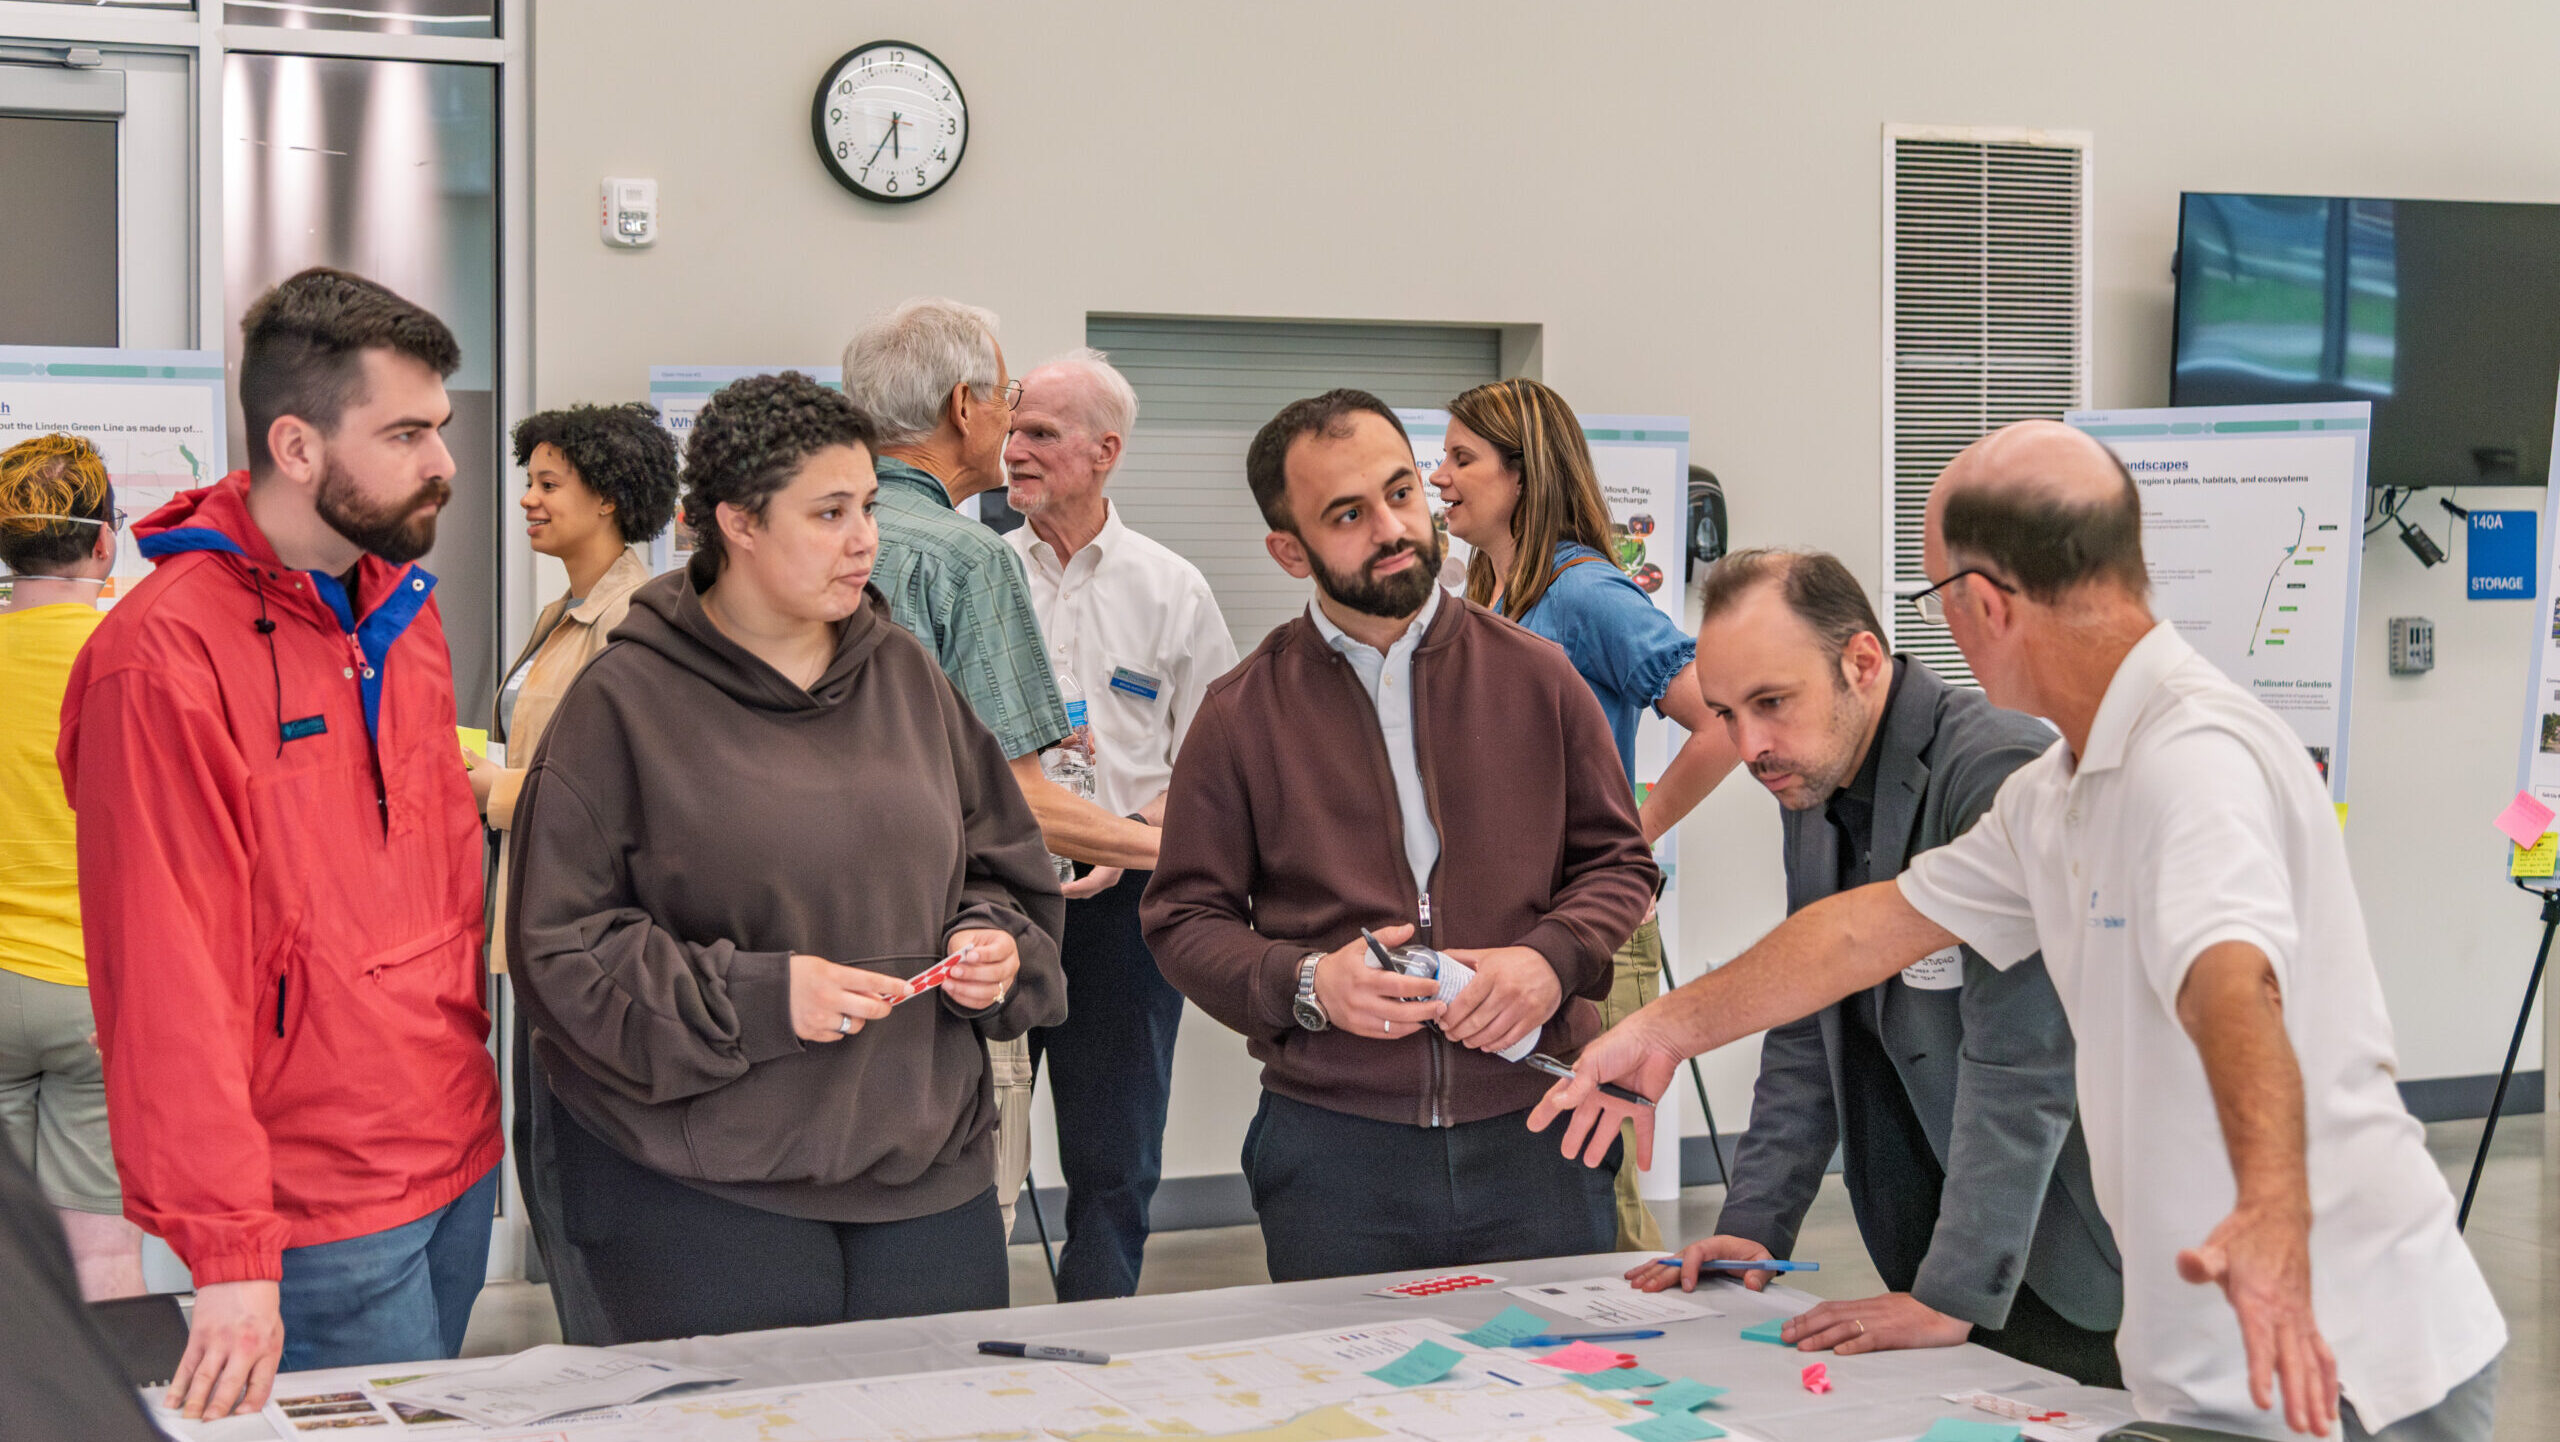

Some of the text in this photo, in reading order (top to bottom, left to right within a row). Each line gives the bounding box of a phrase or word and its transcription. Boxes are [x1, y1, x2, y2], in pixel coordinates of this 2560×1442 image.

[861, 57, 872, 73] 11
[889, 51, 905, 67] 12
[837, 79, 853, 95] 10
[941, 86, 952, 101] 2
[830, 108, 842, 125] 9
[946, 118, 957, 135] 3
[836, 141, 848, 160] 8
[935, 147, 948, 163] 4
[859, 167, 869, 183] 7
[916, 170, 926, 187] 5
[886, 177, 898, 193] 6
[0, 422, 15, 430] out
[17, 422, 33, 430] the
[35, 422, 69, 431] Linden
[71, 422, 101, 432] Green
[103, 423, 124, 432] Line
[126, 425, 138, 433] as
[140, 424, 167, 433] made
[169, 425, 181, 434] up
[2123, 460, 2188, 472] andscapes
[2138, 474, 2309, 487] region's plants, habitats, and ecosystems
[1604, 486, 1630, 495] Move,
[1607, 496, 1649, 506] Recharge
[2472, 514, 2504, 530] 140A
[2471, 576, 2524, 591] STORAGE
[2252, 679, 2333, 689] Pollinator Gardens
